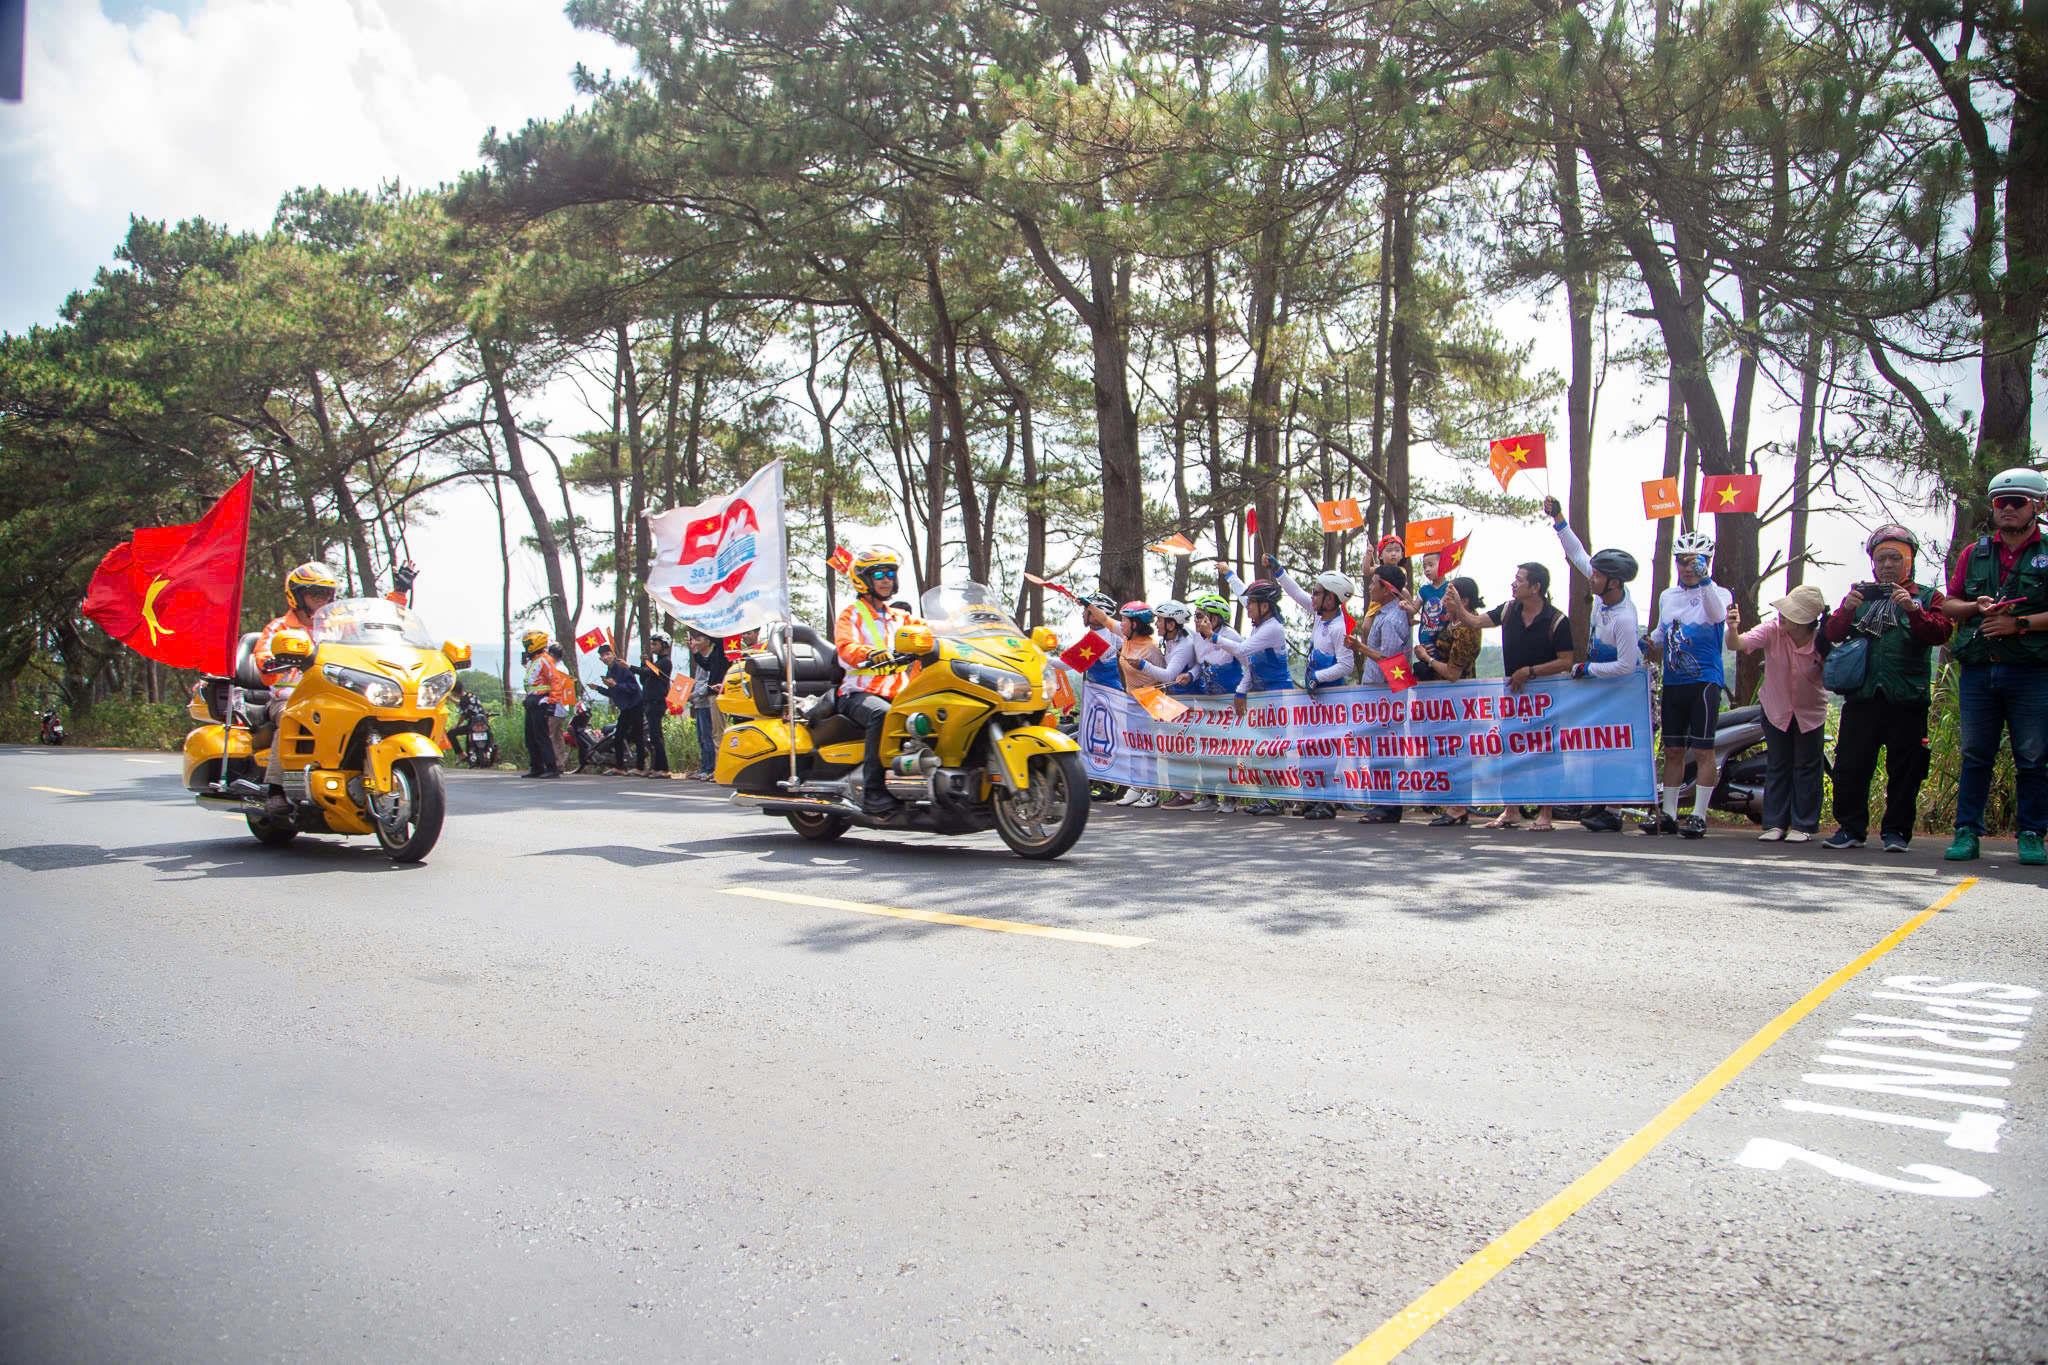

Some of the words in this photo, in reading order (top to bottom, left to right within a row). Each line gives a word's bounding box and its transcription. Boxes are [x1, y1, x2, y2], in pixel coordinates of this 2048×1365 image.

[1247, 703, 1289, 728] CHÀO
[1293, 701, 1347, 726] MỪNG
[1352, 698, 1405, 727] CUỘC
[1410, 699, 1456, 721] ĐUA
[1463, 697, 1493, 721] XE
[1499, 695, 1550, 722] ĐẠP
[1122, 729, 1154, 751] TOÀN
[1156, 729, 1196, 754] QUỐC
[1199, 737, 1255, 756] TRANH
[1255, 735, 1291, 757] CÚP
[1297, 731, 1371, 758] TRUYỀN
[1377, 732, 1429, 757] HÌNH
[1434, 735, 1463, 757] TP
[1469, 726, 1502, 756] HỒ
[1509, 724, 1554, 753] CHÍ
[1560, 725, 1632, 751] MINH
[1228, 762, 1262, 786] LẦN
[1263, 766, 1300, 788] THỨ
[1303, 770, 1326, 789] 37
[1344, 766, 1392, 791] NĂM
[1398, 770, 1451, 792] 2025
[1781, 975, 2042, 1153] SPRINT
